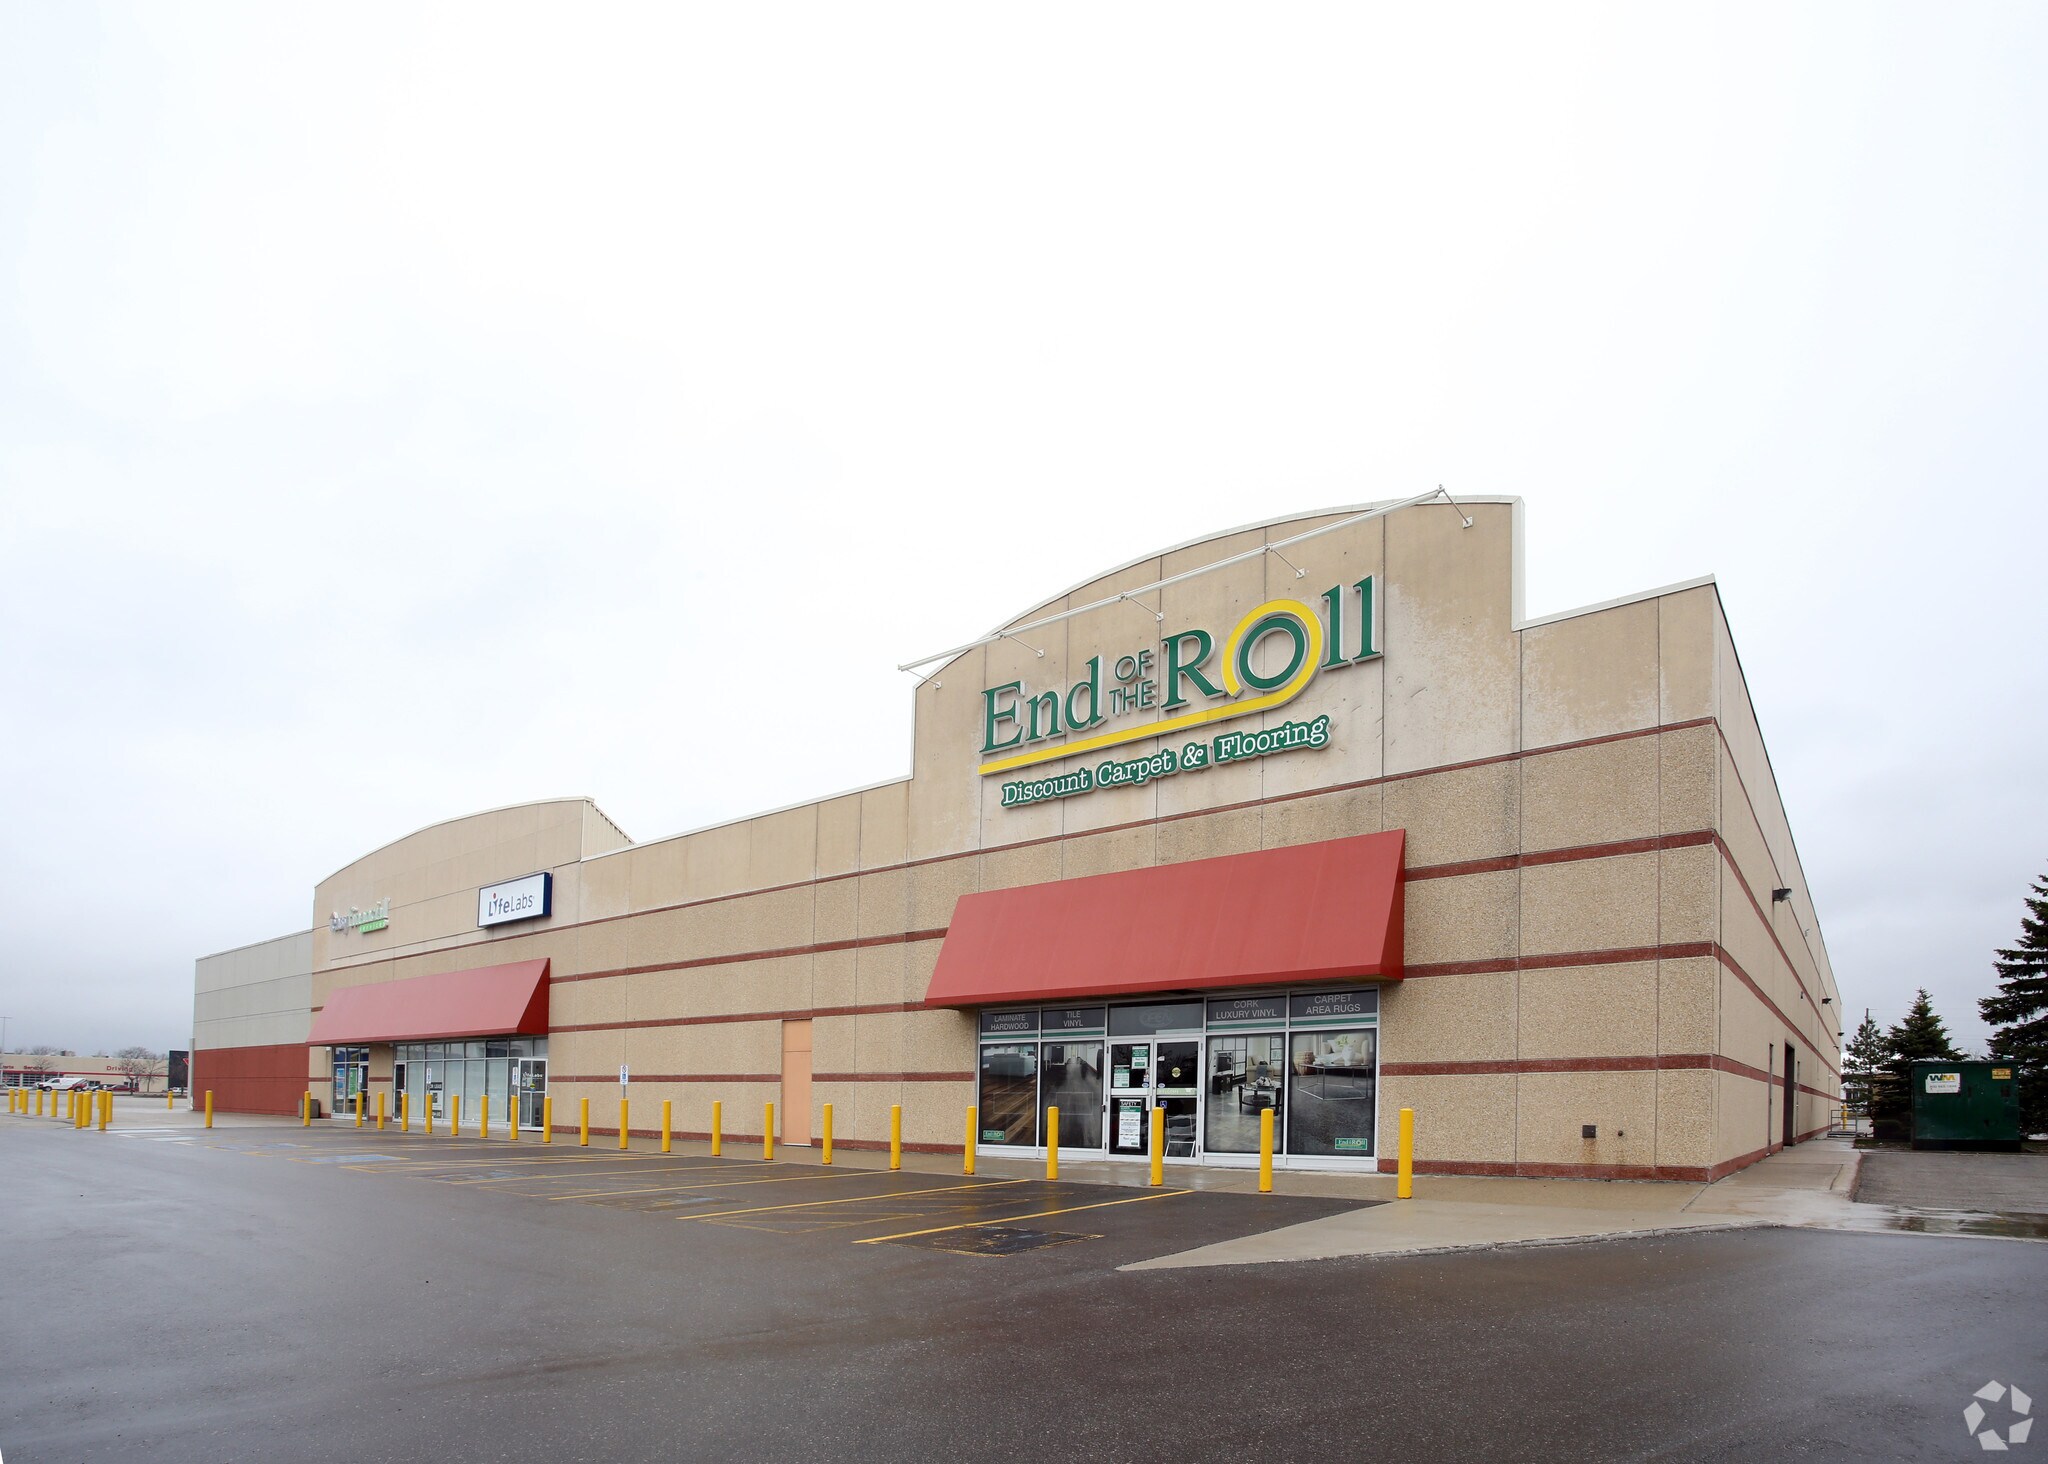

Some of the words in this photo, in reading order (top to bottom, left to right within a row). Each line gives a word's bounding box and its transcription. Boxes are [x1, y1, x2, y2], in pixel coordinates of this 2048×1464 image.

[1114, 648, 1157, 682] OF
[1109, 679, 1158, 716] THE
[979, 655, 1108, 754] End
[1002, 767, 1089, 806] Discount
[1097, 750, 1173, 788] Carpet
[1183, 743, 1205, 770] &
[1217, 716, 1329, 760] Flooring
[488, 892, 533, 917] LifeLabs
[1233, 999, 1260, 1009] CORK
[1314, 993, 1352, 1004] CARPET
[1216, 1009, 1250, 1020] LUXURY
[1251, 1008, 1278, 1018] VINYL
[1306, 1004, 1331, 1015] AREA
[1333, 1003, 1361, 1013] RUGS
[994, 1013, 1026, 1023] LAMINATE
[1066, 1011, 1081, 1019] TILE
[990, 1022, 1029, 1031] HARDWOOD
[1063, 1020, 1084, 1028] VINYL
[106, 1065, 133, 1073] Driving
